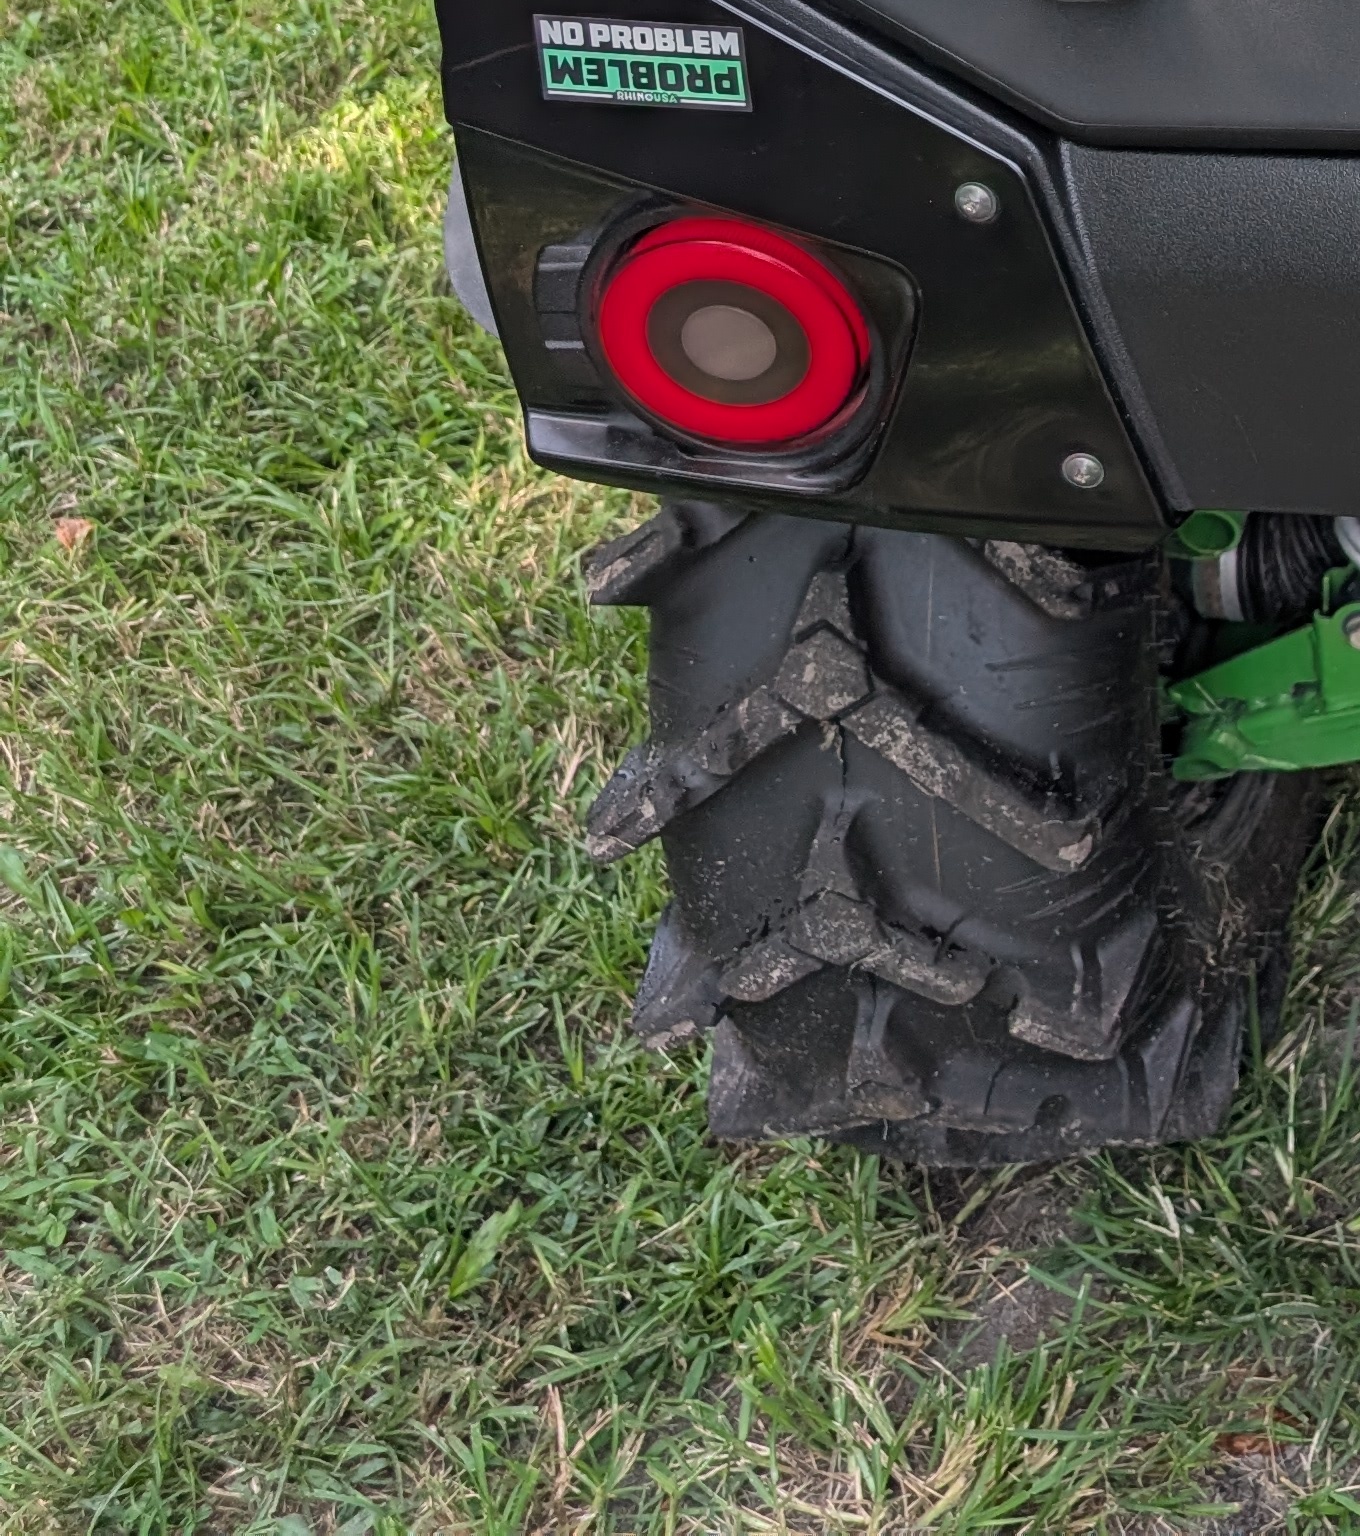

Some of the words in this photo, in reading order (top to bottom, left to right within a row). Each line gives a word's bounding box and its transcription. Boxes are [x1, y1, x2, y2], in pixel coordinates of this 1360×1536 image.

[539, 19, 584, 46] NO
[589, 22, 740, 56] PROBLEM
[548, 54, 741, 96] PROBLEM
